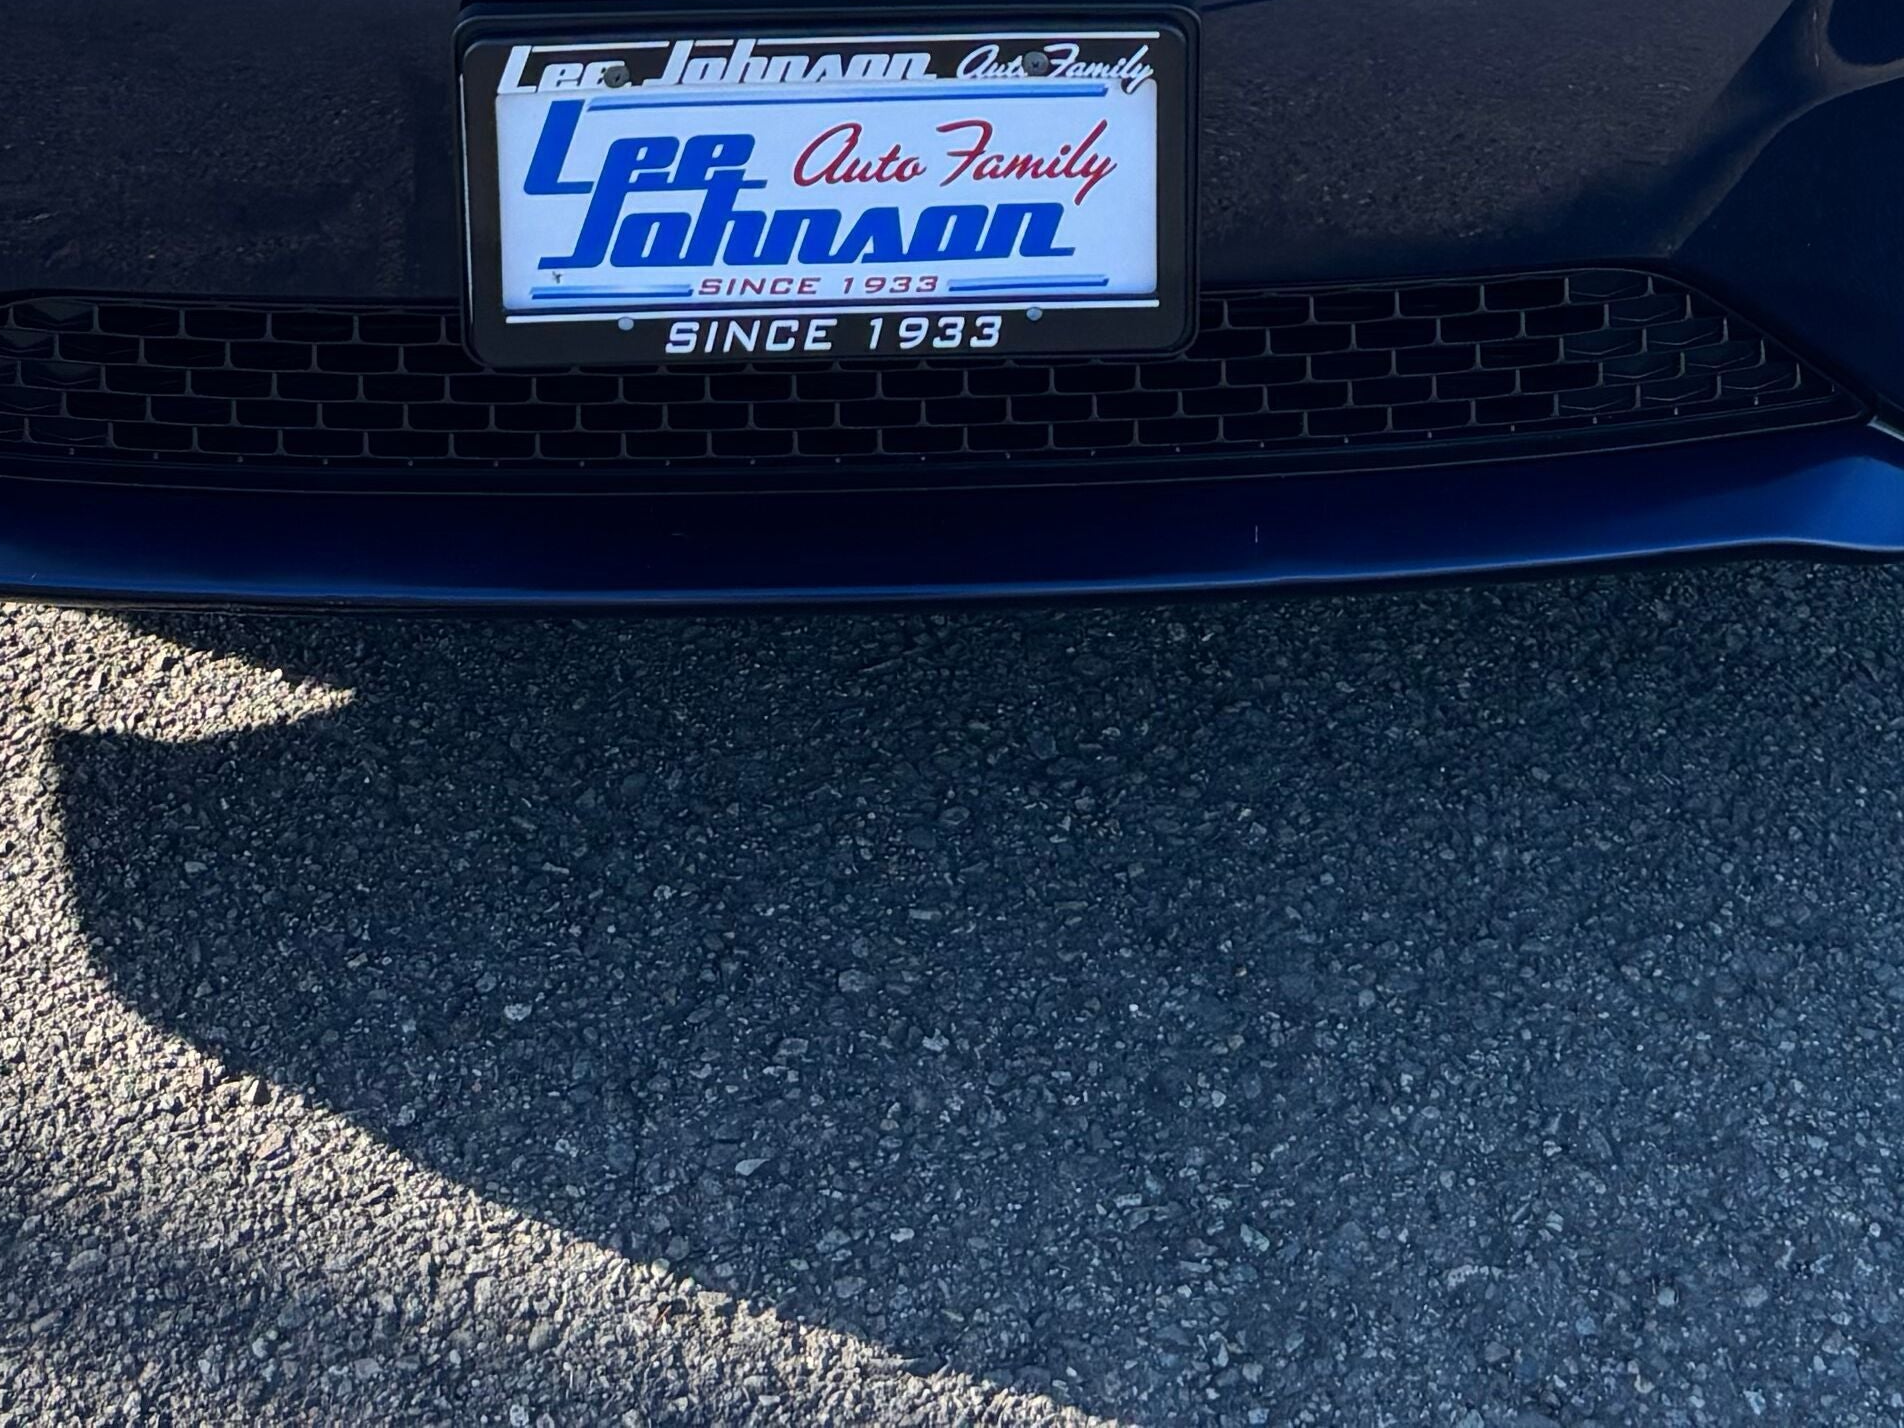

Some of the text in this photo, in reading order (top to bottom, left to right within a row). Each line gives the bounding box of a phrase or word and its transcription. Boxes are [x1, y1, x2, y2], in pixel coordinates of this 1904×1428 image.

[497, 40, 1154, 94] Lee Johnson Aut Family
[523, 99, 1118, 207] Lee Auto Family
[537, 170, 1076, 270] Johnson
[698, 275, 940, 296] SINCE 1933
[664, 314, 1003, 354] SINCE 1933
